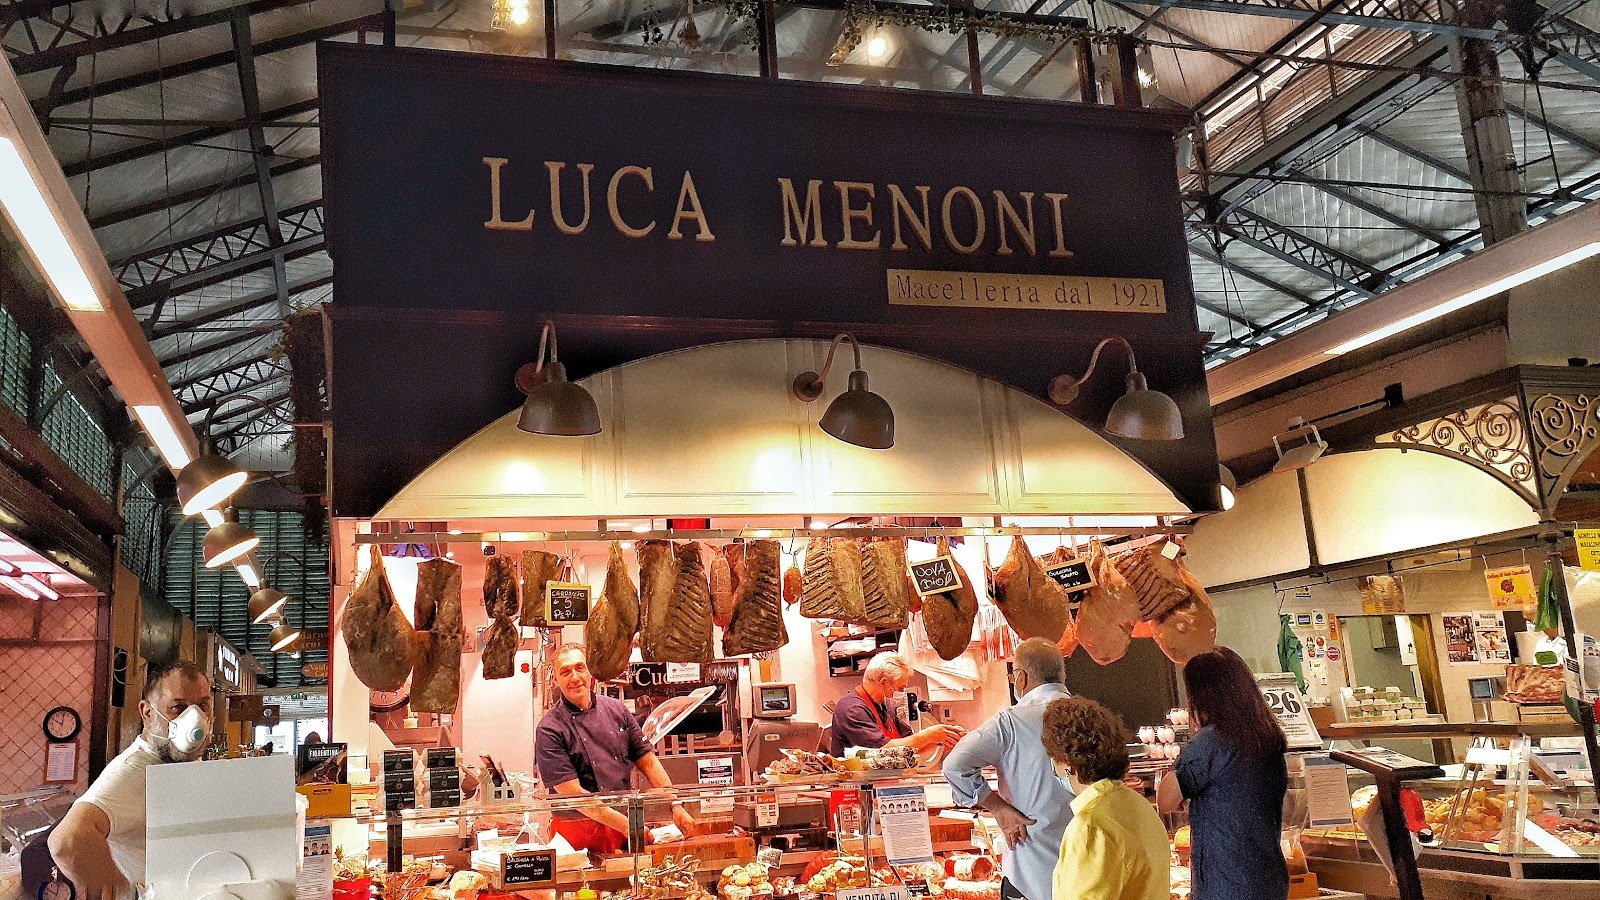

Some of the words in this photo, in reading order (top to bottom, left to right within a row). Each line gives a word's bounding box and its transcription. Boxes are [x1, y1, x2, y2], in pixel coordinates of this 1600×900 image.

[483, 156, 715, 241] LUCA
[778, 178, 1074, 258] MENONI
[896, 274, 1040, 303] Macelleria
[1055, 280, 1091, 305] dal
[1111, 282, 1165, 307] 1921
[564, 597, 572, 609] 5
[635, 667, 702, 687] Cuc
[1263, 691, 1301, 714] 26
[309, 748, 339, 757] FIORENTINA
